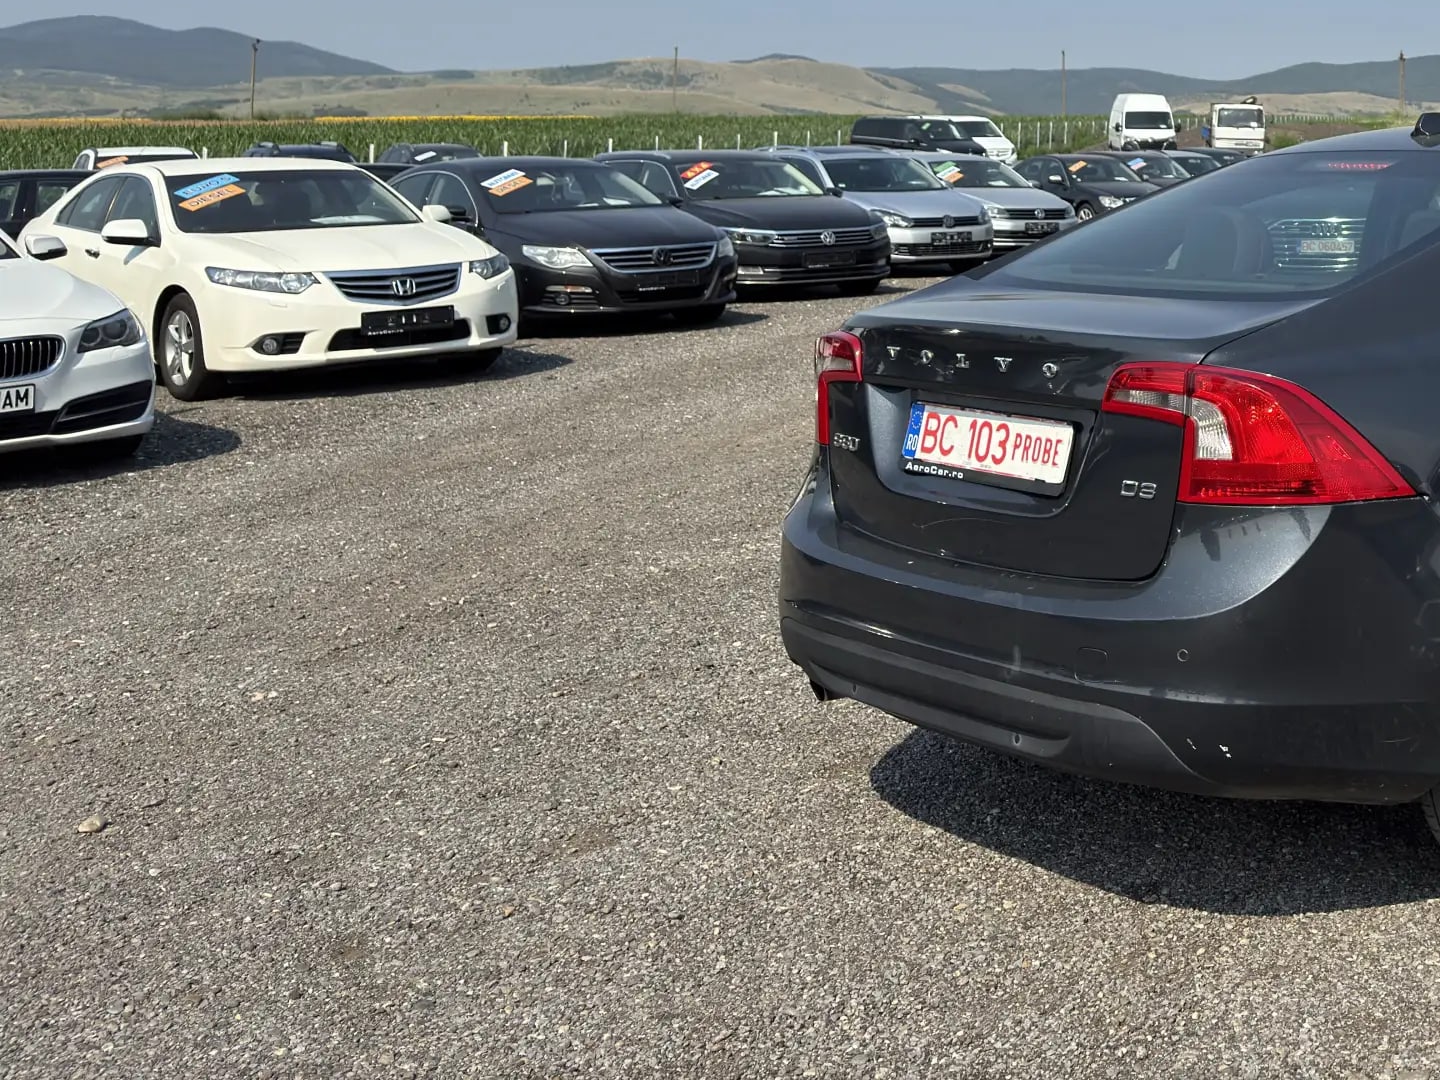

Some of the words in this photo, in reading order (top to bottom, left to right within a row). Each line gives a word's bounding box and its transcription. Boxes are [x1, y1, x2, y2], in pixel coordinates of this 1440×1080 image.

[189, 187, 234, 207] DIESEL
[886, 345, 1058, 378] VOLVO
[0, 387, 29, 409] AM
[905, 433, 918, 451] RO
[920, 411, 958, 457] BC
[967, 418, 1010, 466] 103
[1011, 432, 1063, 467] PROBE
[905, 460, 964, 480] AeroCar.ro
[1120, 479, 1157, 499] D3
